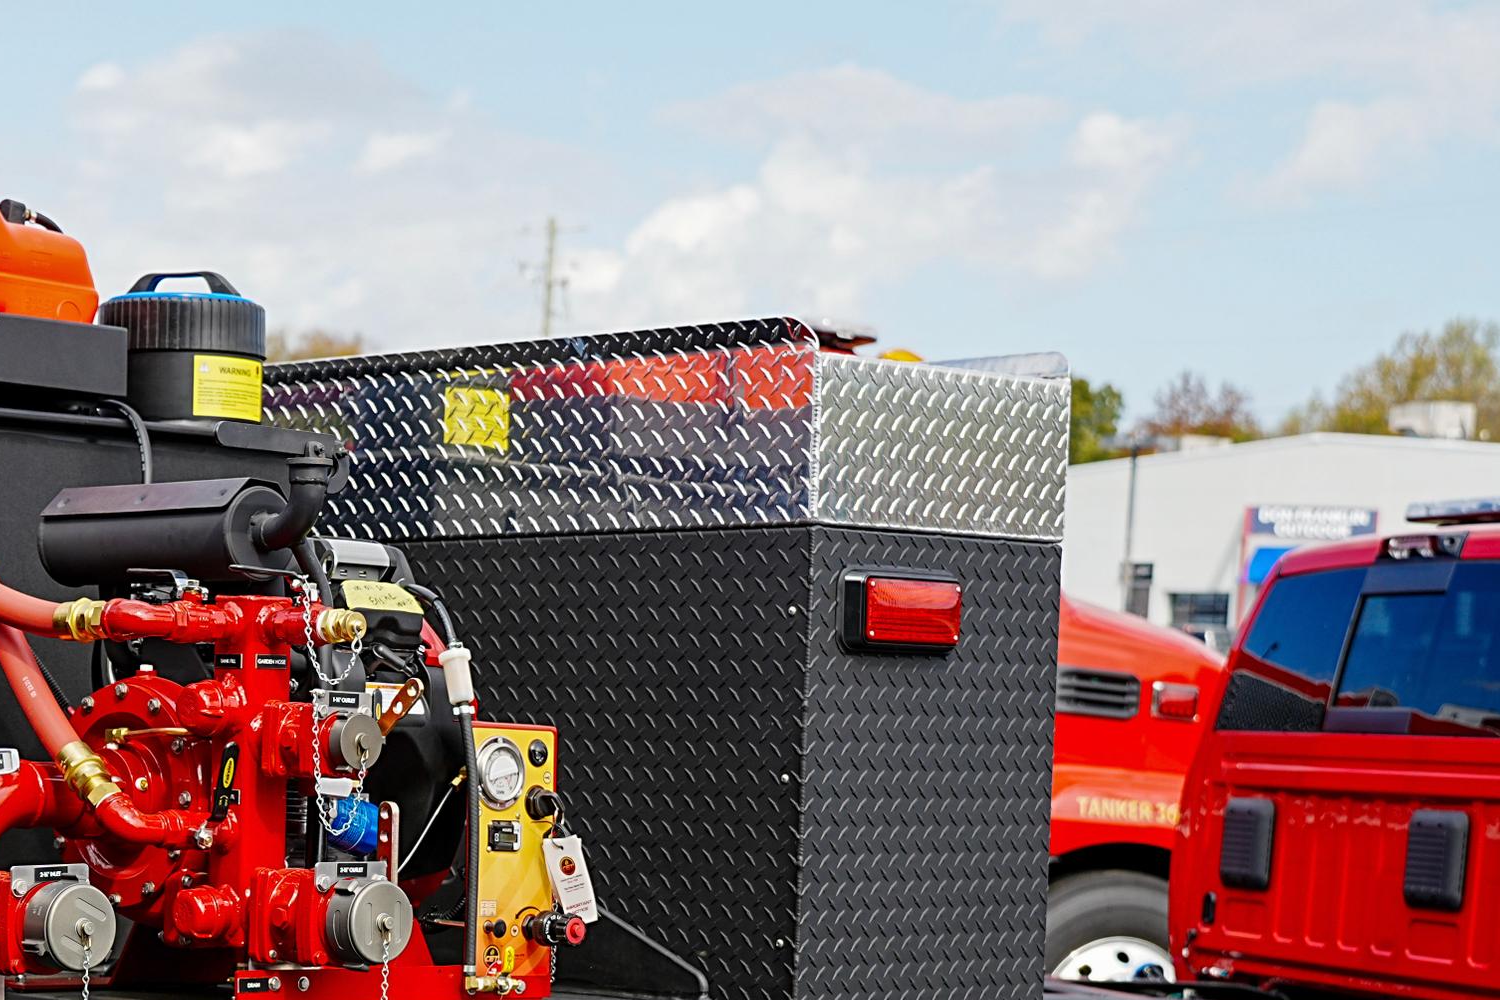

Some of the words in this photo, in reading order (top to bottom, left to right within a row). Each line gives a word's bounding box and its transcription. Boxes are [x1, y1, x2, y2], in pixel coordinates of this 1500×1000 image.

[219, 366, 252, 377] WARNING
[1076, 795, 1152, 822] TANKER
[566, 899, 592, 911] IMPORTANT
